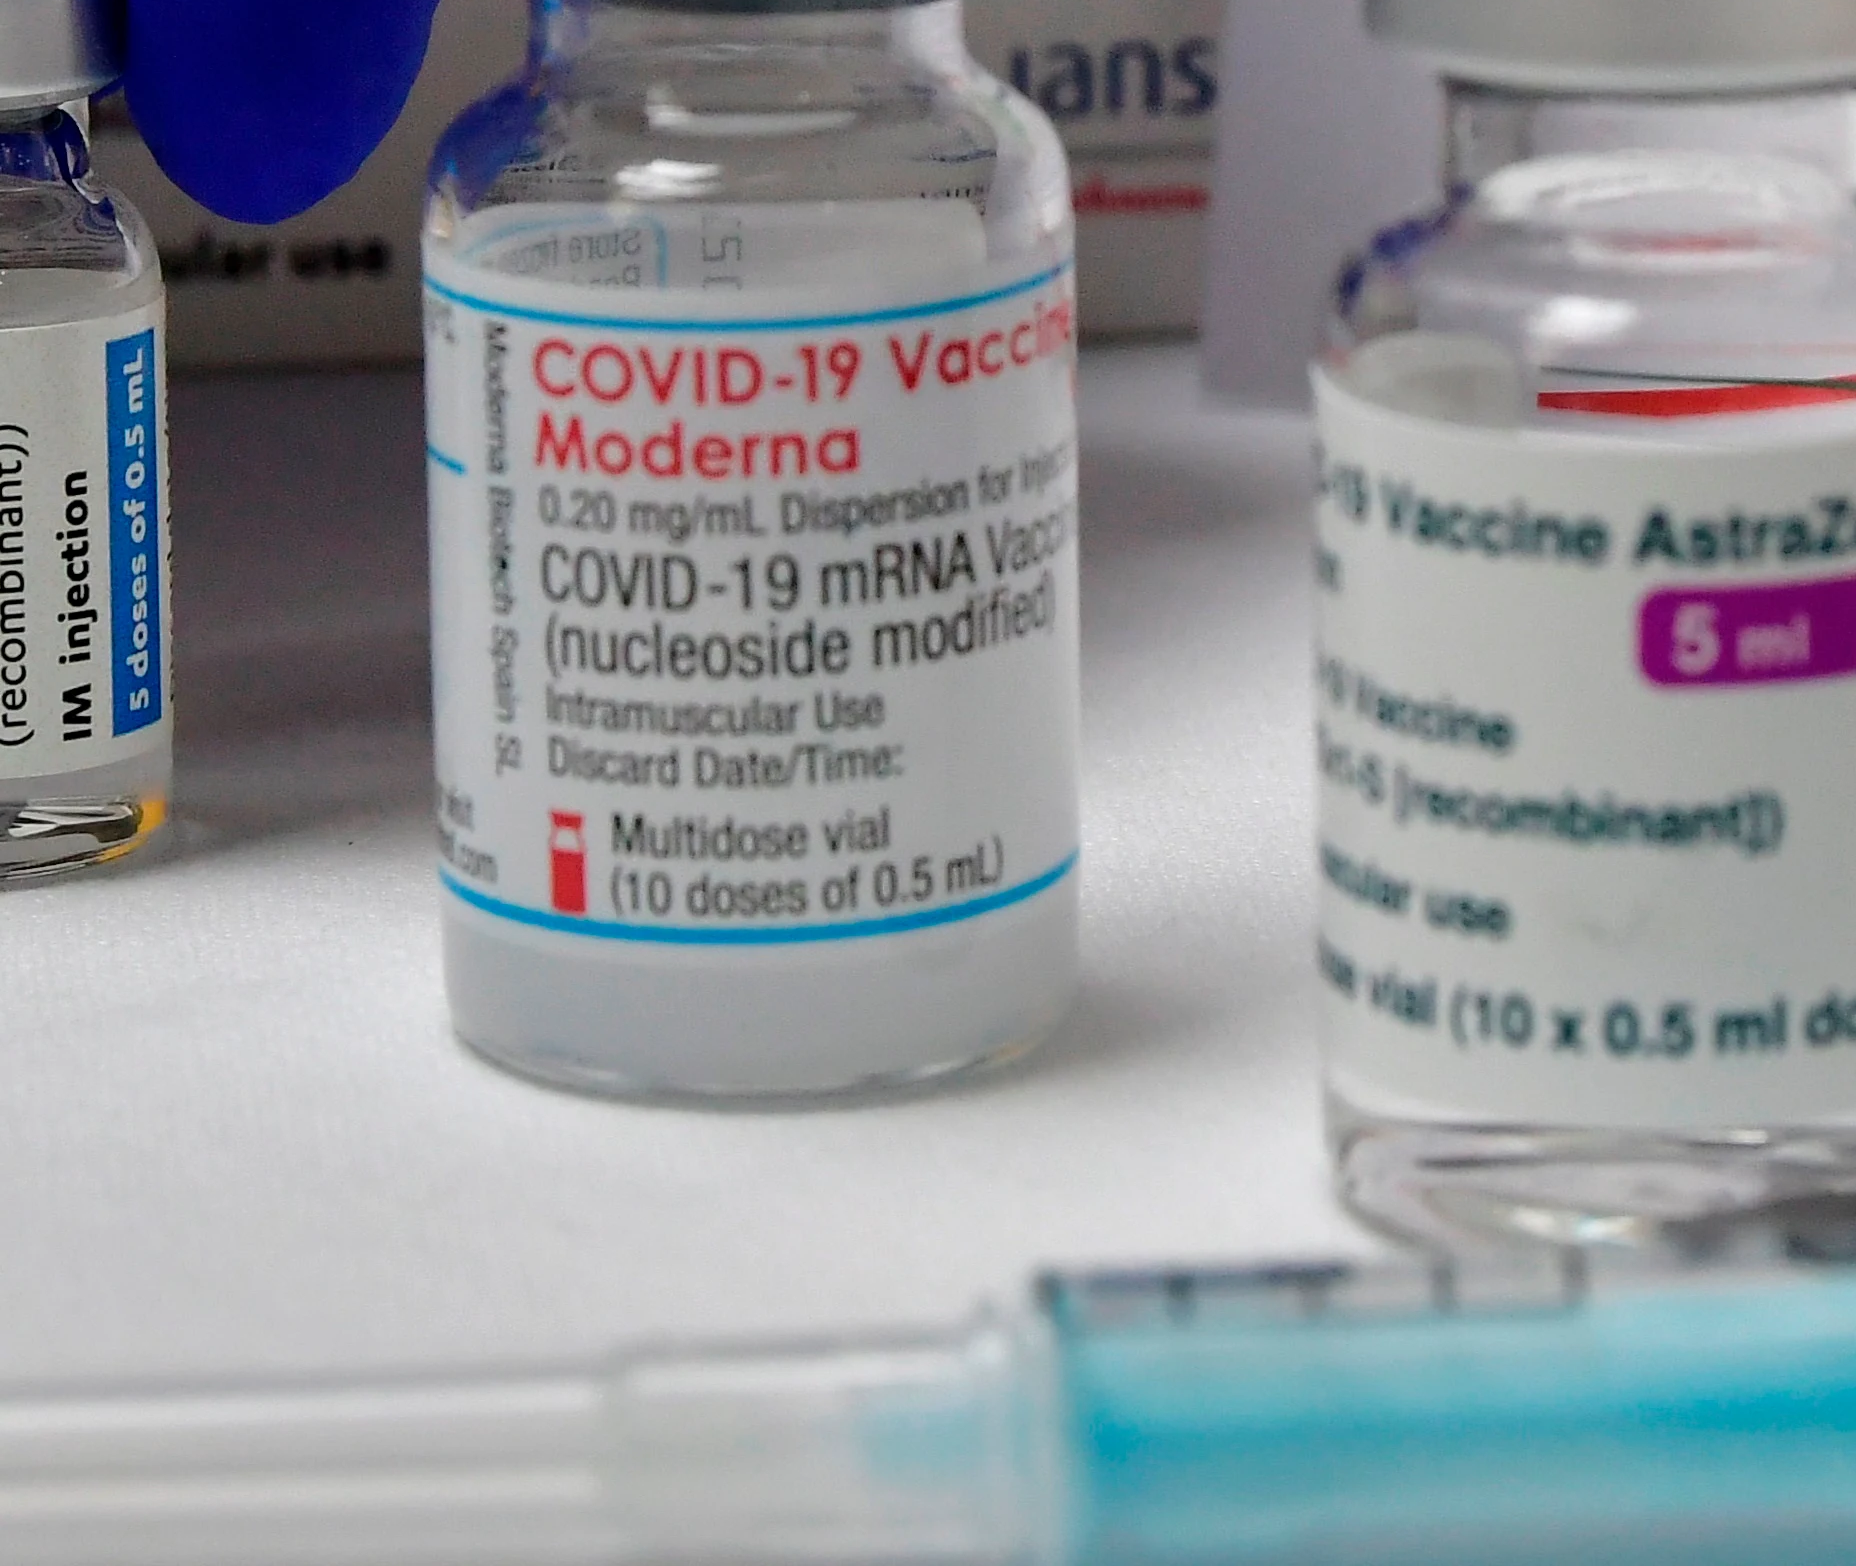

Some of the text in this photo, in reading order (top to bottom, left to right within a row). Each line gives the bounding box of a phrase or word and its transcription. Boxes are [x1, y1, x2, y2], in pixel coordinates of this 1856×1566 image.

[483, 320, 510, 476] Moderna
[531, 335, 863, 405] COVID-19
[533, 408, 862, 482] Moderna
[121, 347, 149, 712] 5 doses of 0.5 mL
[537, 483, 617, 535] 0.20
[628, 491, 768, 545] mg/mL
[780, 475, 970, 537] Dispersion
[974, 464, 1013, 508] for
[1378, 475, 1612, 568] Vaccine
[56, 470, 98, 741] IM injection
[540, 542, 800, 613] COVID-19
[819, 533, 976, 605] mRNA
[543, 617, 853, 680] (nucleoside
[1669, 600, 1813, 677] 5 ml
[544, 685, 887, 736] Intramuscular Use
[547, 735, 905, 792] Discard Date/Time:
[610, 807, 892, 862] Multidose vial
[610, 834, 1006, 921] (10 doses of 0.5 mL)
[1421, 888, 1514, 937] use
[1449, 986, 1535, 1051] (10
[1547, 1005, 1589, 1056] x
[1600, 995, 1697, 1060] 0.5
[1713, 992, 1791, 1057] ml
